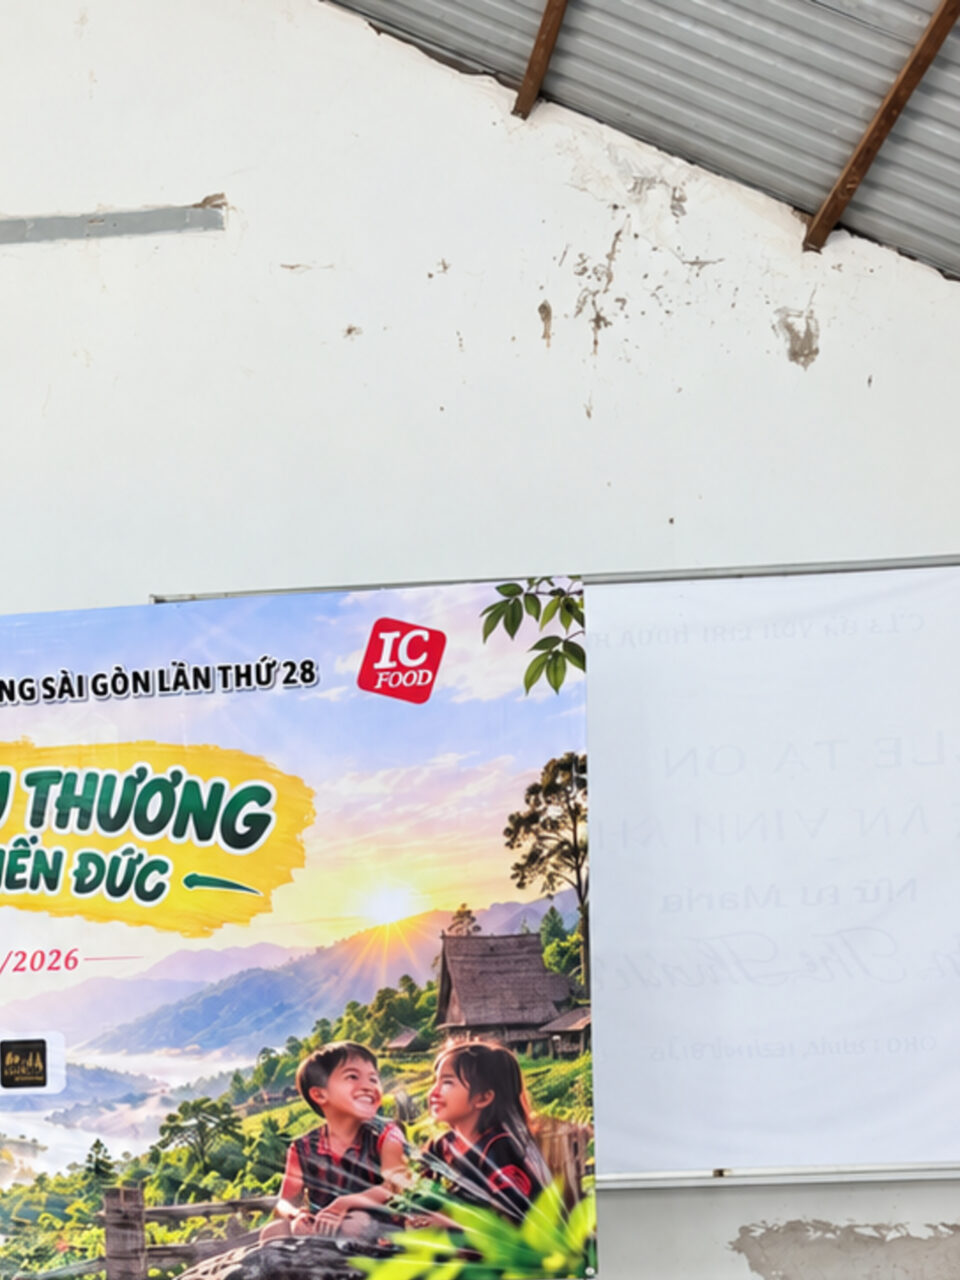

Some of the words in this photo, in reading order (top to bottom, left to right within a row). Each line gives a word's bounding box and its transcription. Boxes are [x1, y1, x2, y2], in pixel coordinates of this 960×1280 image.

[373, 629, 430, 669] IC
[42, 670, 85, 699] SÀI
[91, 666, 150, 696] GÒN
[158, 661, 211, 692] LẦN
[218, 656, 277, 688] THỨ
[282, 660, 316, 684] 28
[374, 669, 433, 689] FOOD
[26, 766, 272, 850] THƯƠNG
[72, 847, 169, 902] ĐỨC
